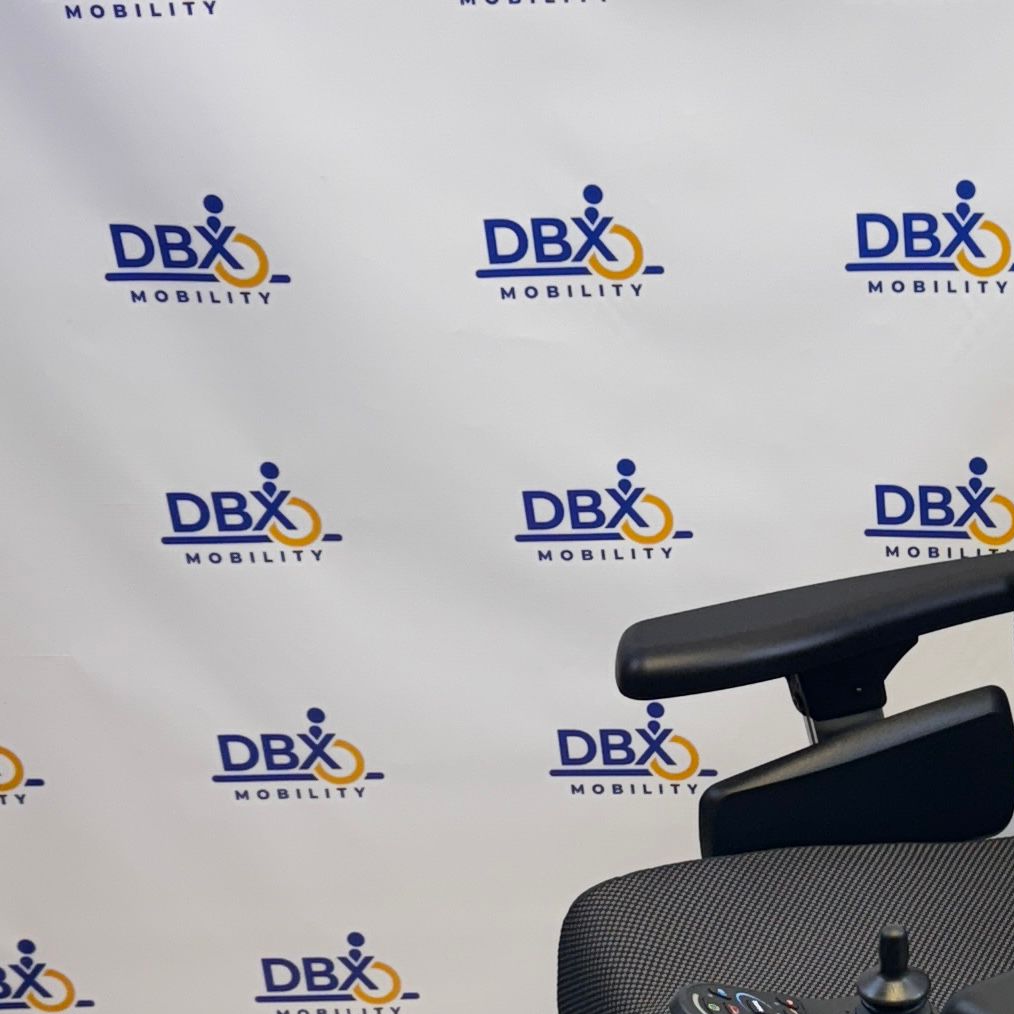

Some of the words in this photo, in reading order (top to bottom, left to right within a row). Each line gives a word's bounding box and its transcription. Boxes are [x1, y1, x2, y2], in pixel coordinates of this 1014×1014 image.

[65, 2, 217, 19] MOBILITY
[109, 223, 244, 270] DBX
[483, 217, 618, 264] DBX
[856, 212, 985, 258] DBX
[130, 290, 270, 304] MOBILITY
[500, 284, 642, 300] MOBILITY
[868, 280, 1007, 294] MOBILITY
[165, 492, 297, 533] DBX
[522, 488, 650, 531] DBX
[875, 484, 996, 529] DBX
[185, 550, 322, 564] MOBILITY
[538, 547, 672, 561] MOBILITY
[217, 733, 341, 771] DBX
[557, 728, 677, 766] DBX
[235, 787, 364, 800] MOBILITY
[571, 784, 699, 795] MOBILITY
[261, 957, 379, 993] DBX
